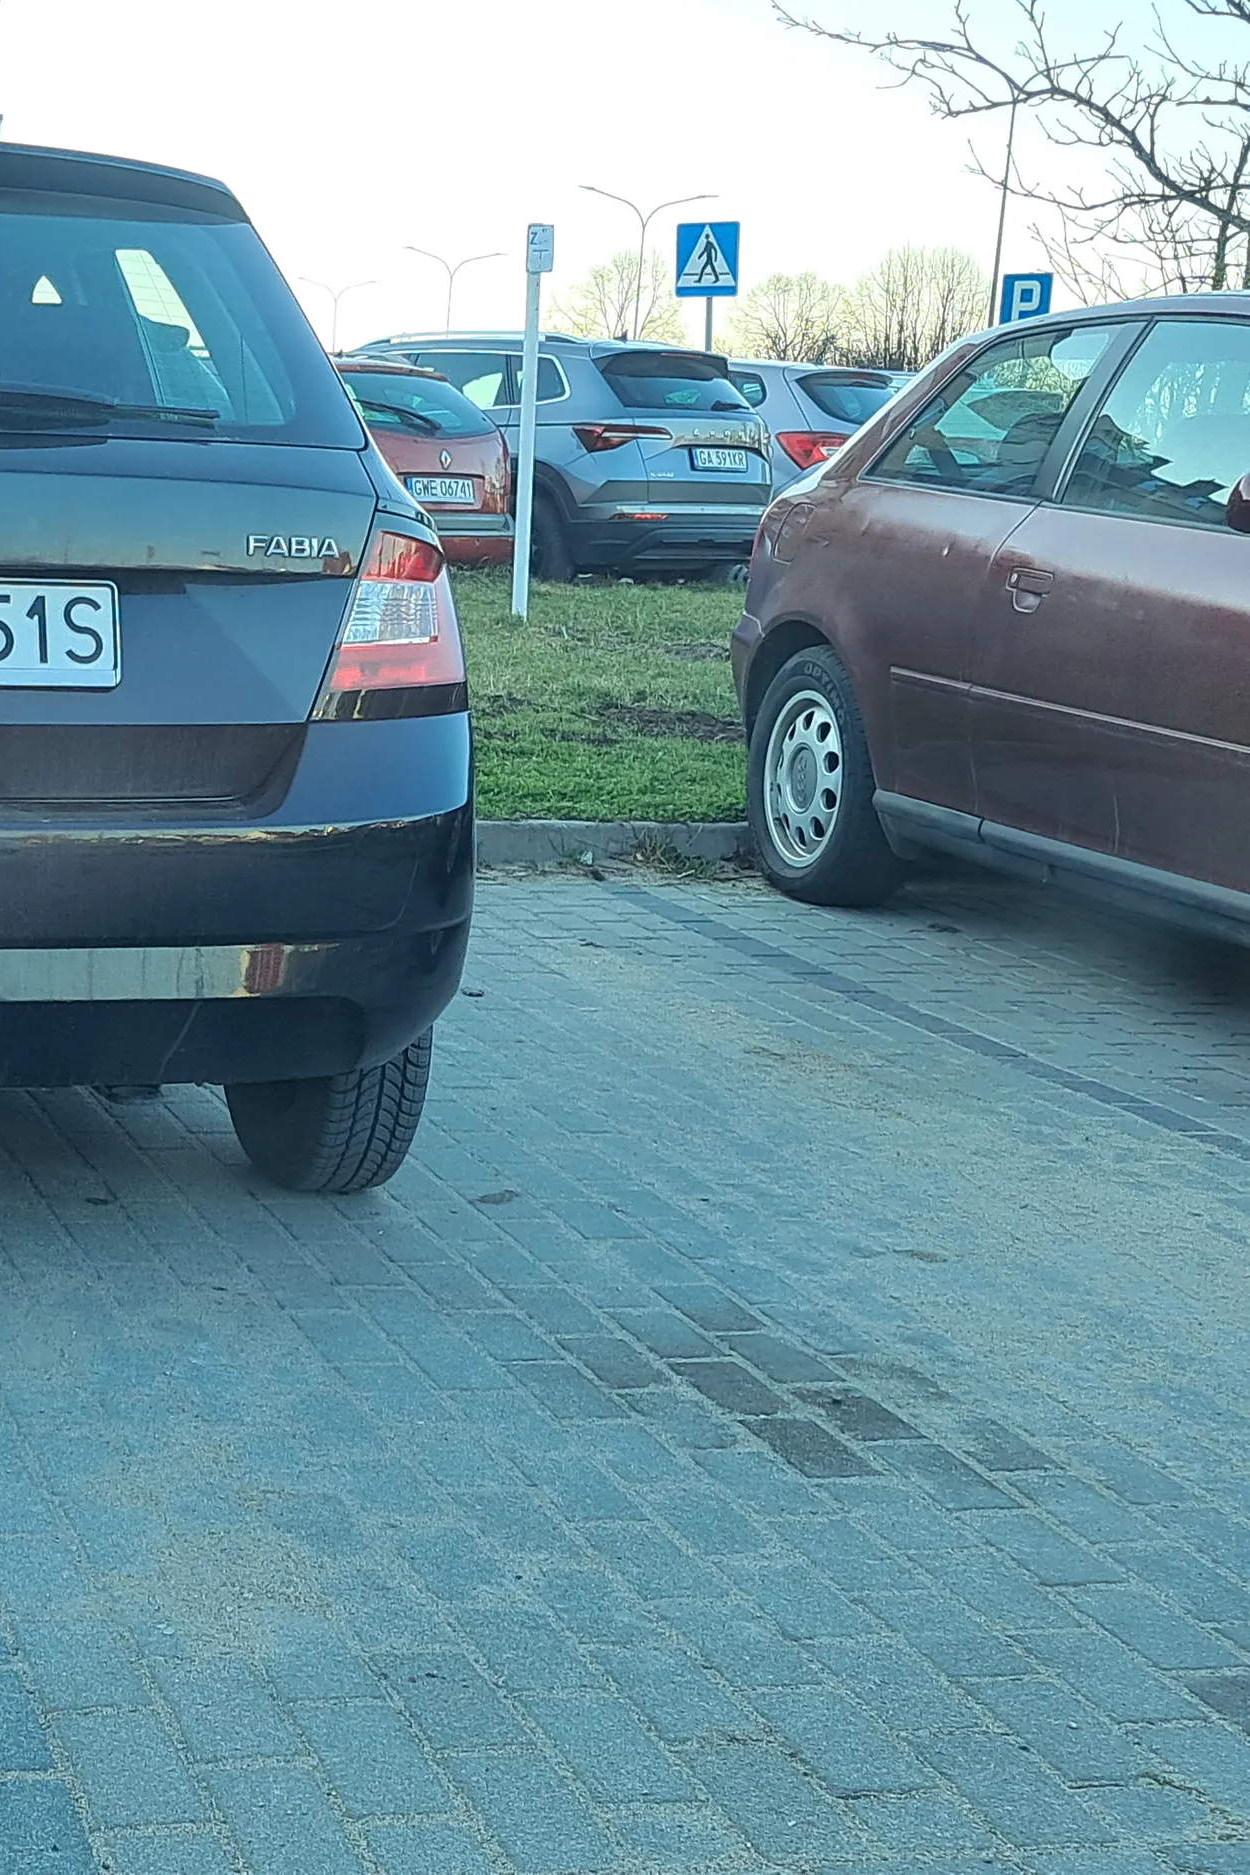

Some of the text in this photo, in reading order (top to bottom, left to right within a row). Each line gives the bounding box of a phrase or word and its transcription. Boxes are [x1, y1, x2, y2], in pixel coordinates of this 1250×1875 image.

[1011, 280, 1041, 321] P
[699, 450, 714, 467] GA
[414, 480, 471, 498] GWE 06741
[248, 535, 340, 559] FABIA
